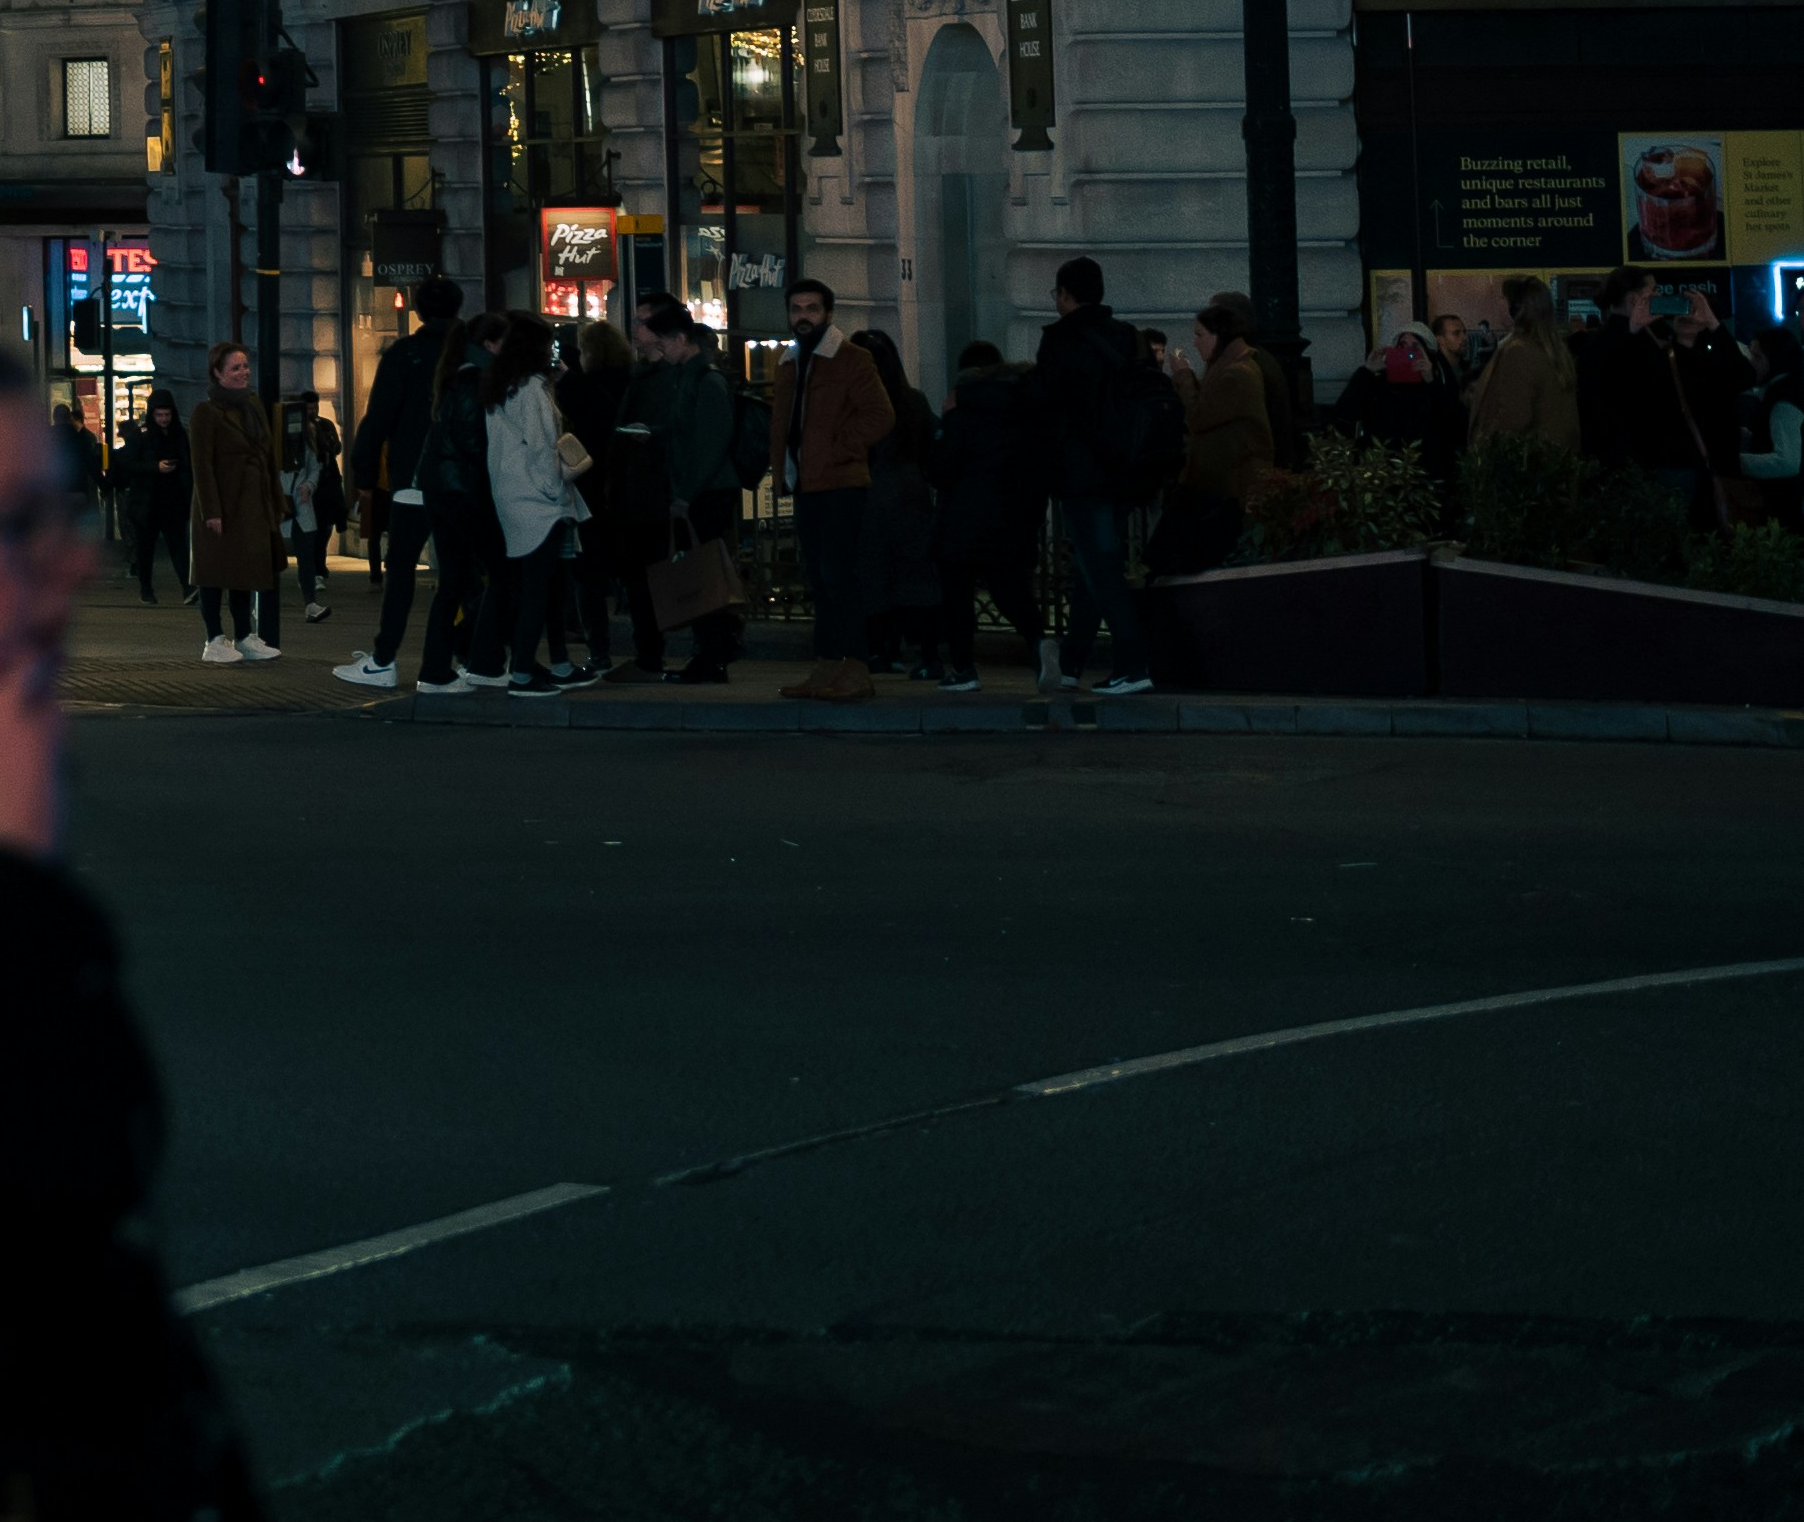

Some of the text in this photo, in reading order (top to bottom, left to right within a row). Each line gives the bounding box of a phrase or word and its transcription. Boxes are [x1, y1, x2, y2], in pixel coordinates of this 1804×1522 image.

[1020, 12, 1038, 29] BANK
[814, 32, 828, 47] BANK
[1019, 40, 1041, 57] HOUSE
[1459, 155, 1572, 173] Buzzing retail,
[1460, 176, 1607, 193] unique restaurants
[1461, 193, 1584, 211] and bars all just
[1462, 212, 1594, 228] moments around
[550, 223, 610, 246] Pizza
[1462, 233, 1542, 248] the corner
[558, 245, 602, 265] Hut
[377, 263, 434, 276] OSPREY
